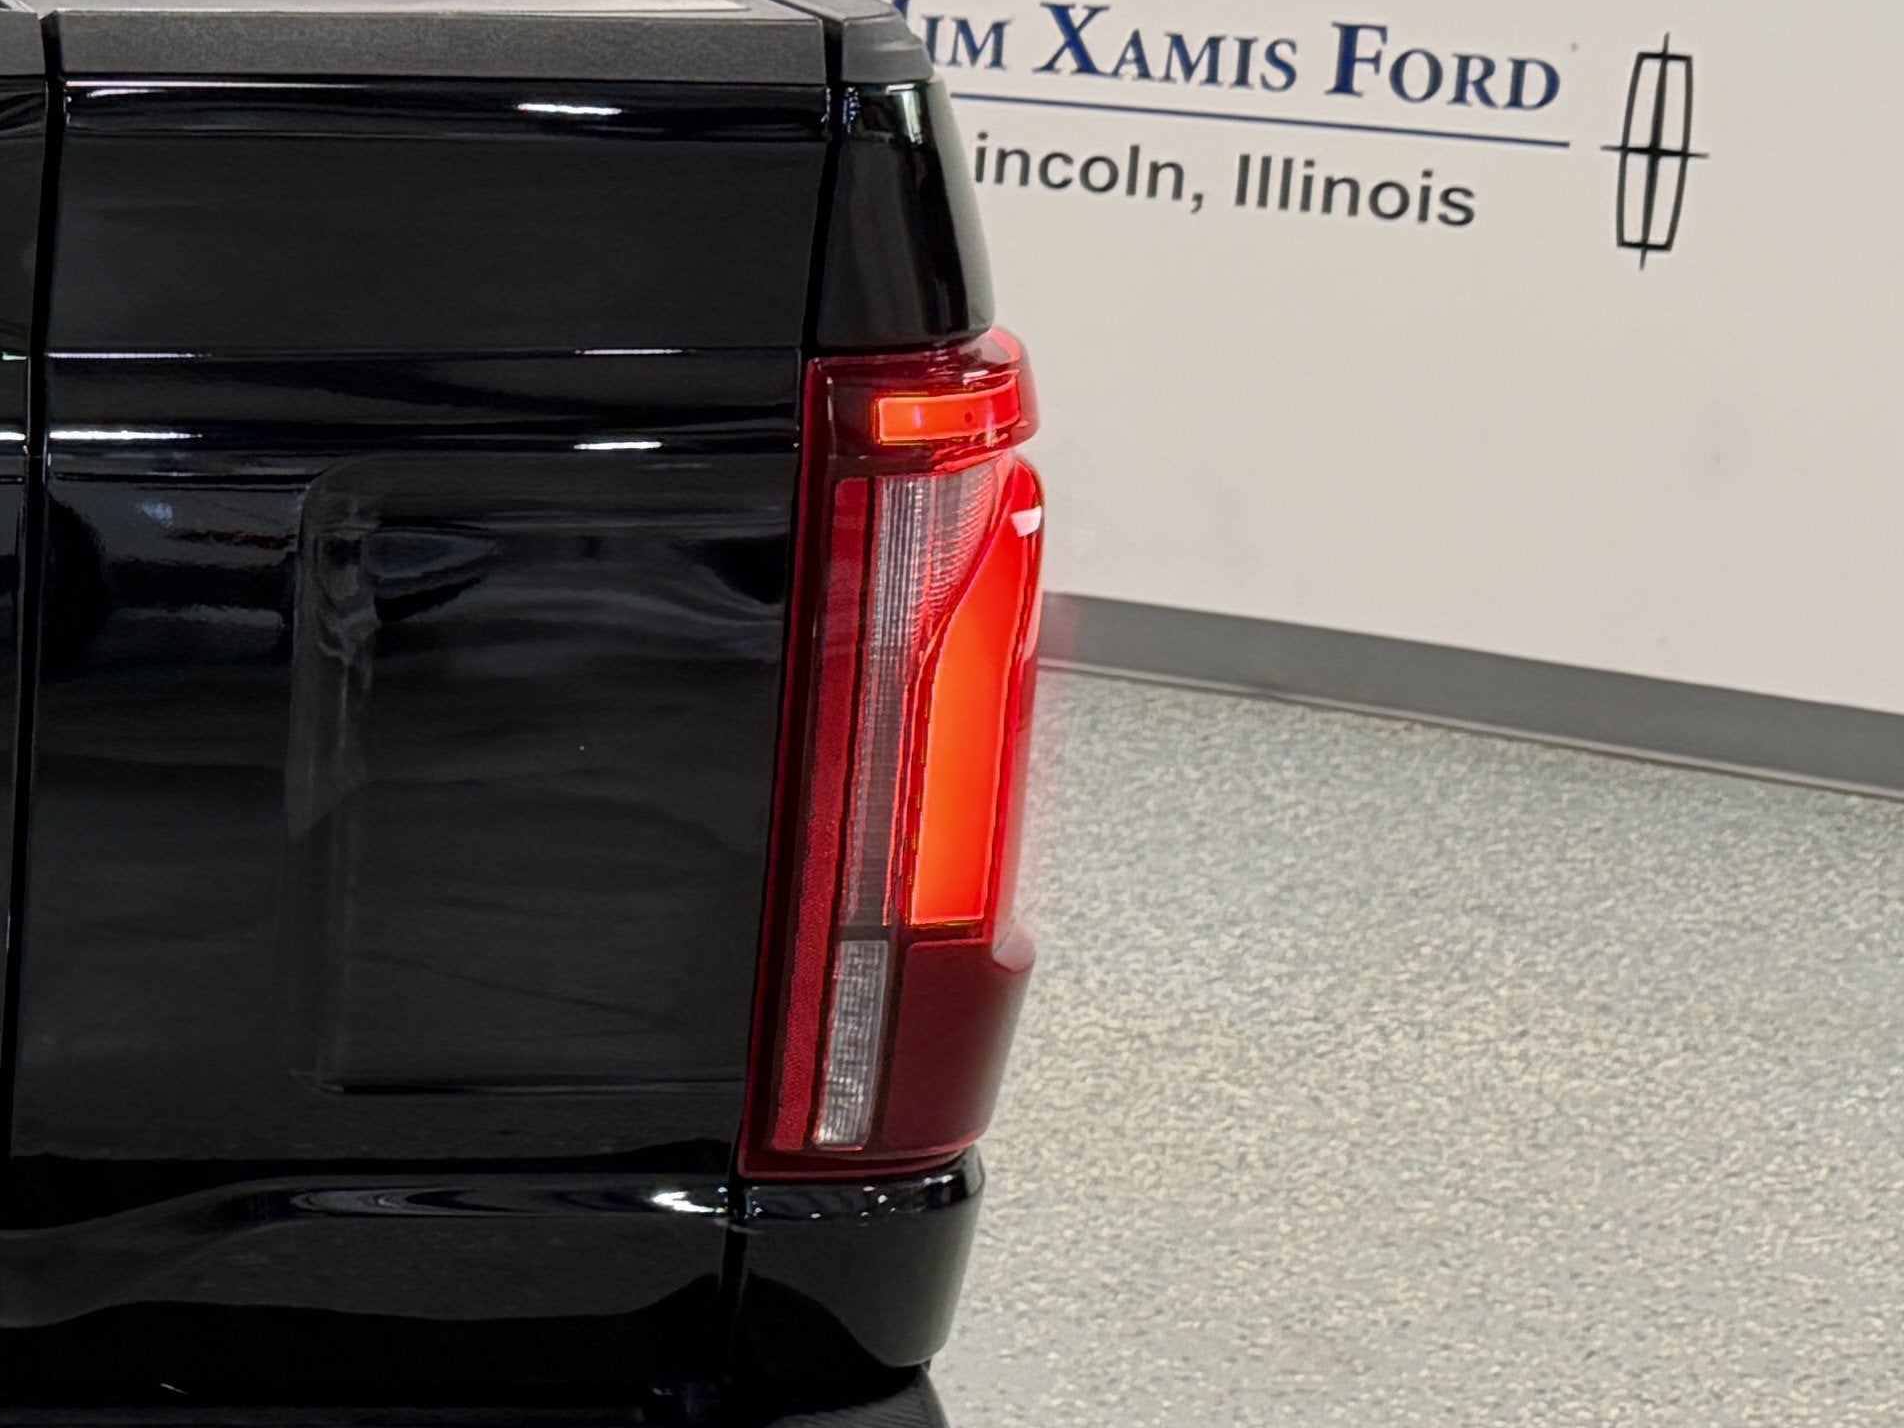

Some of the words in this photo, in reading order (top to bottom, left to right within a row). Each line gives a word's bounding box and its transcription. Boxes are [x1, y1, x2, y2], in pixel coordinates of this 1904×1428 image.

[1033, 1, 1299, 93] XAMIS
[1324, 20, 1562, 112] FORD
[974, 131, 1206, 215] incoln,
[1233, 153, 1478, 227] Illinois
